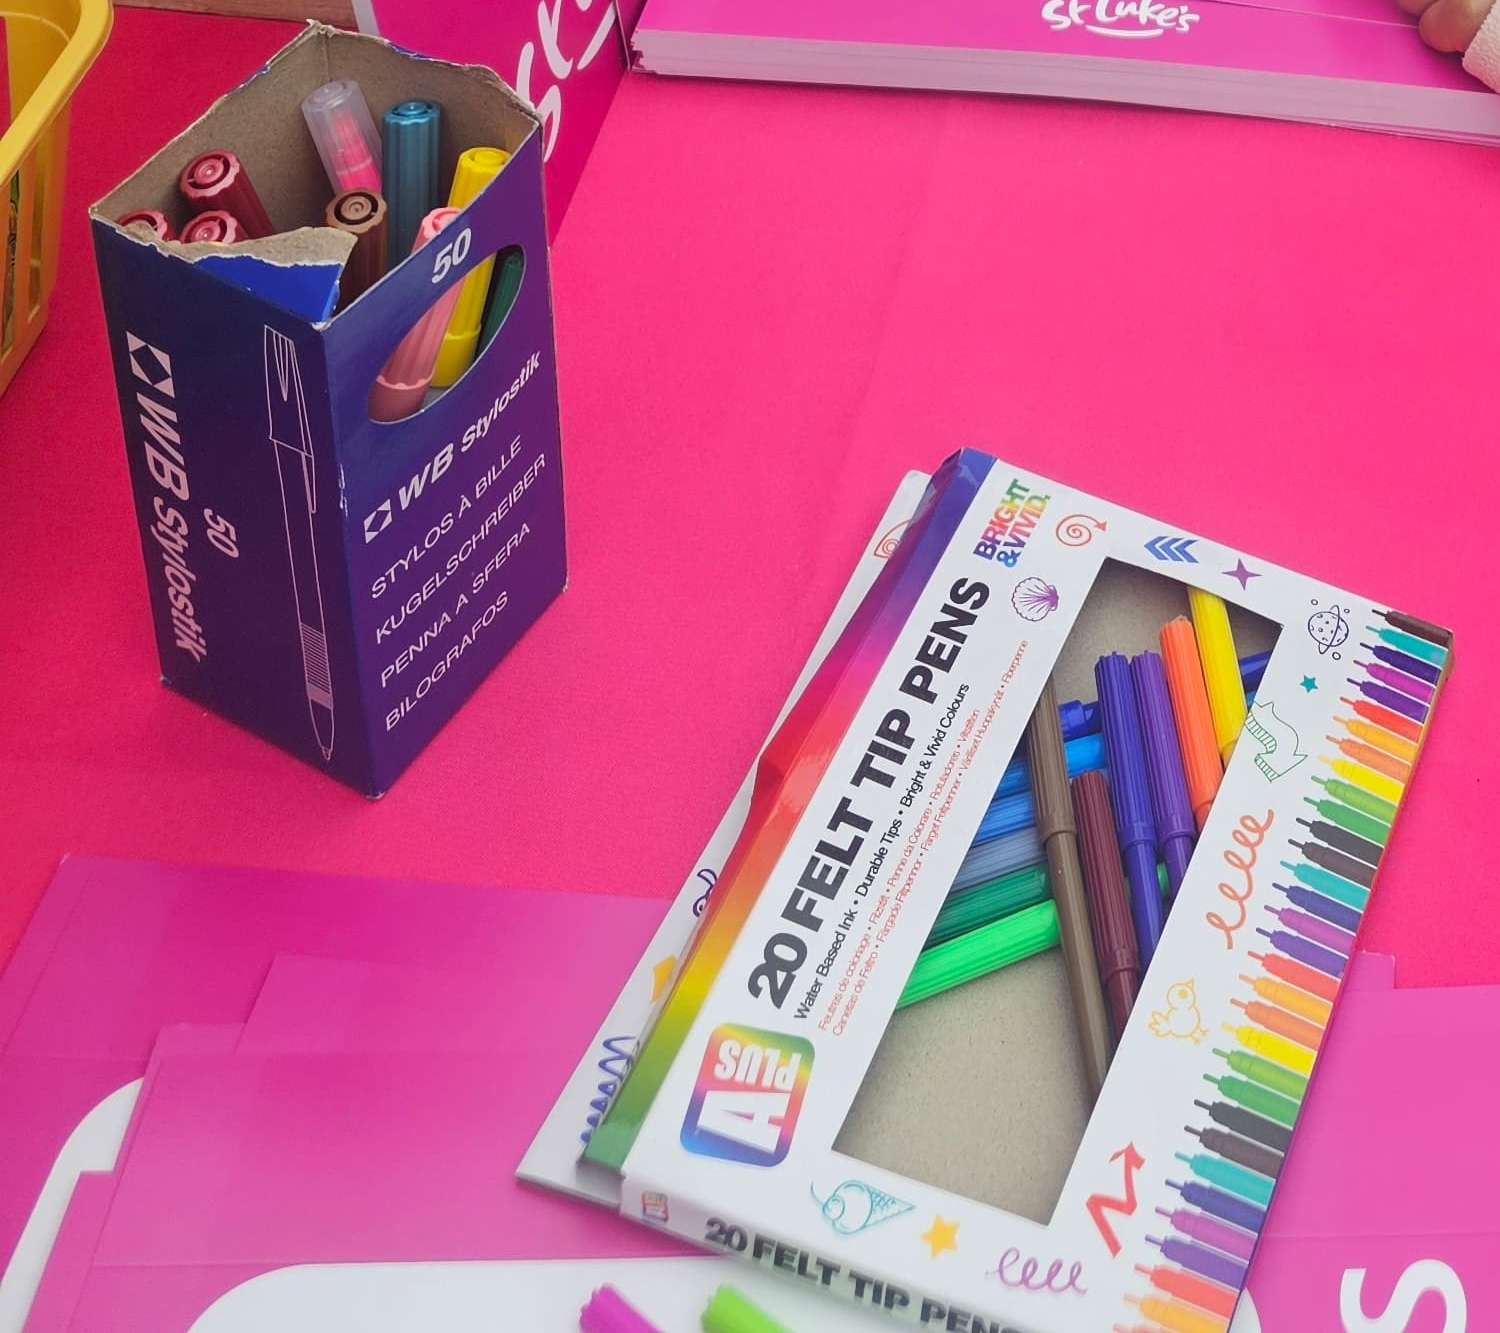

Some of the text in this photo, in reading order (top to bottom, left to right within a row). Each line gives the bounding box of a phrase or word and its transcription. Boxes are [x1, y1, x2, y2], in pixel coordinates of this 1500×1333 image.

[431, 226, 472, 285] 50
[397, 349, 542, 512] WB Stylostik
[136, 391, 208, 664] WB Stylostik
[203, 507, 240, 559] 50
[371, 435, 522, 600] STYLOS À BILLE
[375, 451, 547, 644] KUGELSCHREIBER
[972, 477, 1032, 561] BRIGHT
[996, 549, 1022, 569] &
[380, 521, 533, 689] PENNA A SFERA
[385, 590, 509, 734] BILOGRAFOS
[747, 575, 991, 1011] 20 FELT TIP PENS
[793, 683, 971, 1021] Water Based Ink Durable Tips Bright & Vivid Colours
[836, 976, 850, 993] de
[713, 1038, 802, 1092] PLUS
[704, 1216, 748, 1253] 20
[752, 1234, 841, 1287] FELT
[848, 1269, 910, 1312] TIP
